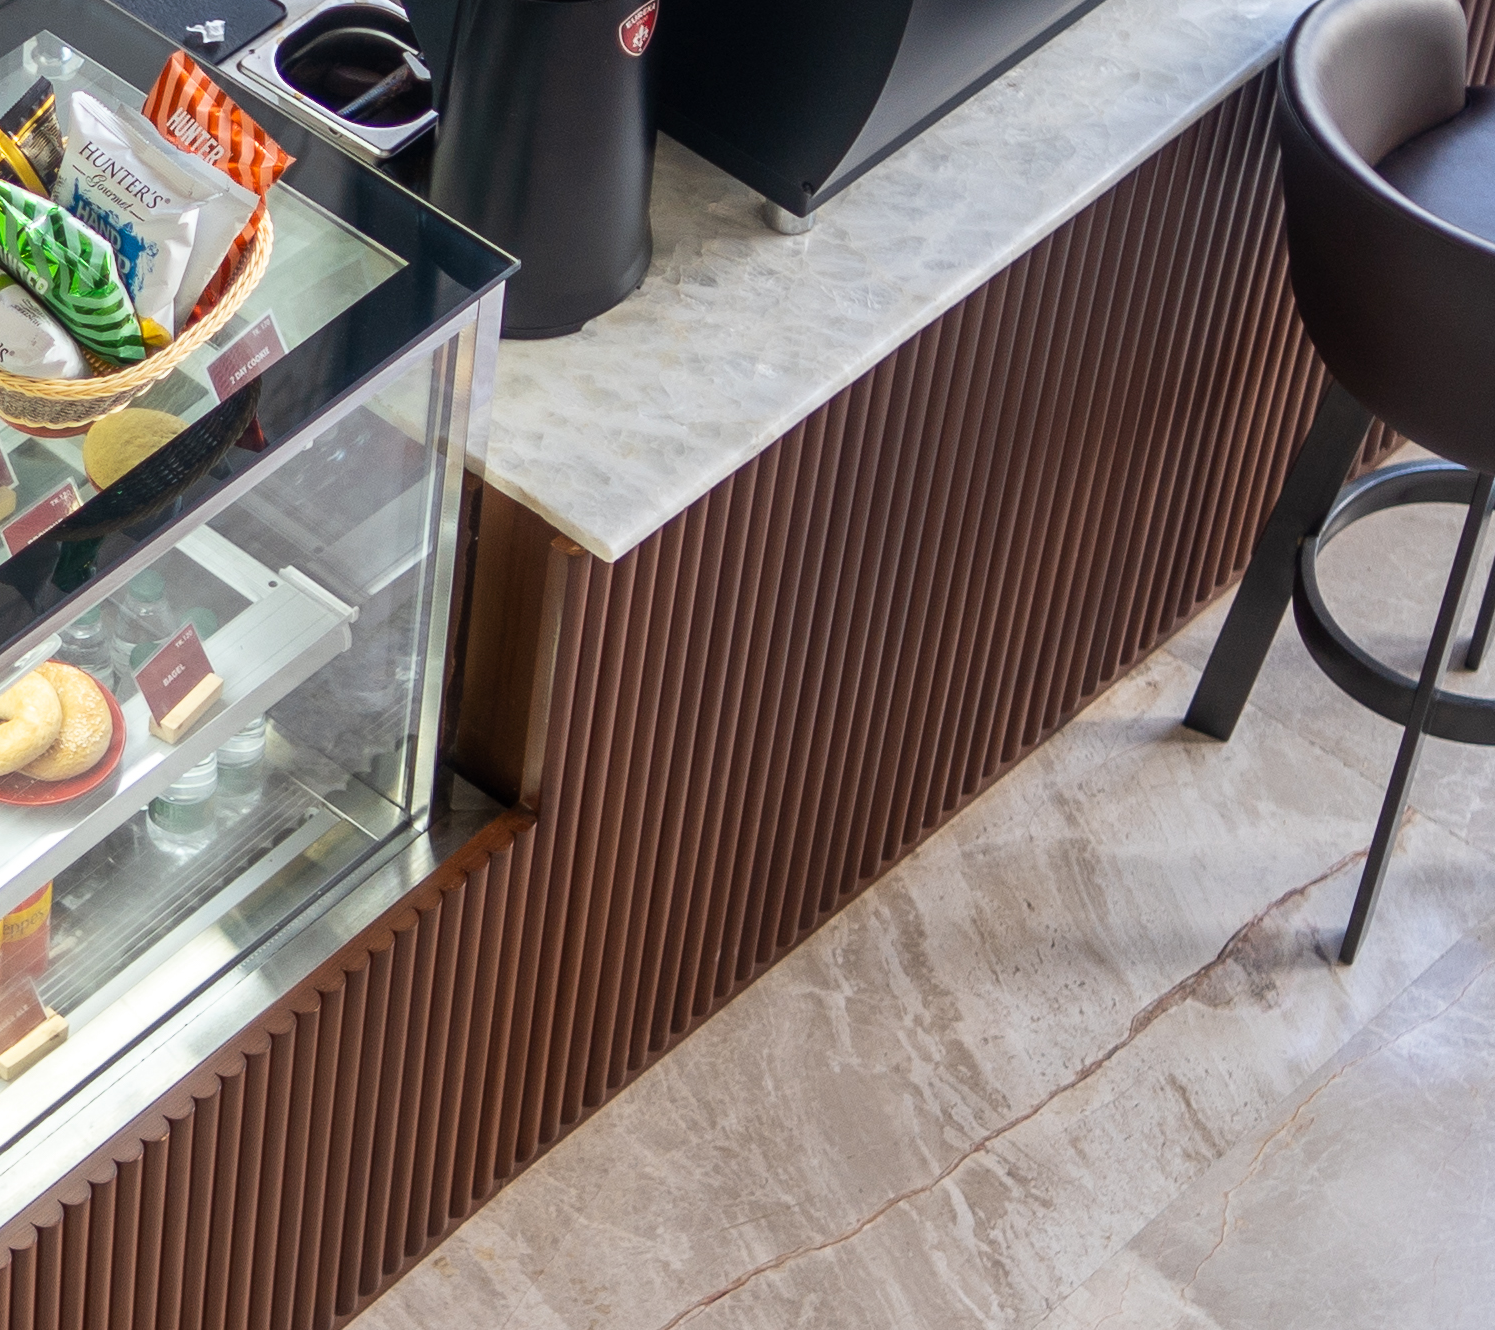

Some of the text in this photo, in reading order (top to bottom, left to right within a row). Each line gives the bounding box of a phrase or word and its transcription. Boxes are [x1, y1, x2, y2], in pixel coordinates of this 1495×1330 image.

[625, 2, 656, 29] EUREKA
[79, 140, 165, 210] HUNTER'S
[234, 367, 249, 382] DAY
[246, 345, 271, 373] COOKIE
[161, 661, 187, 687] BAGEL
